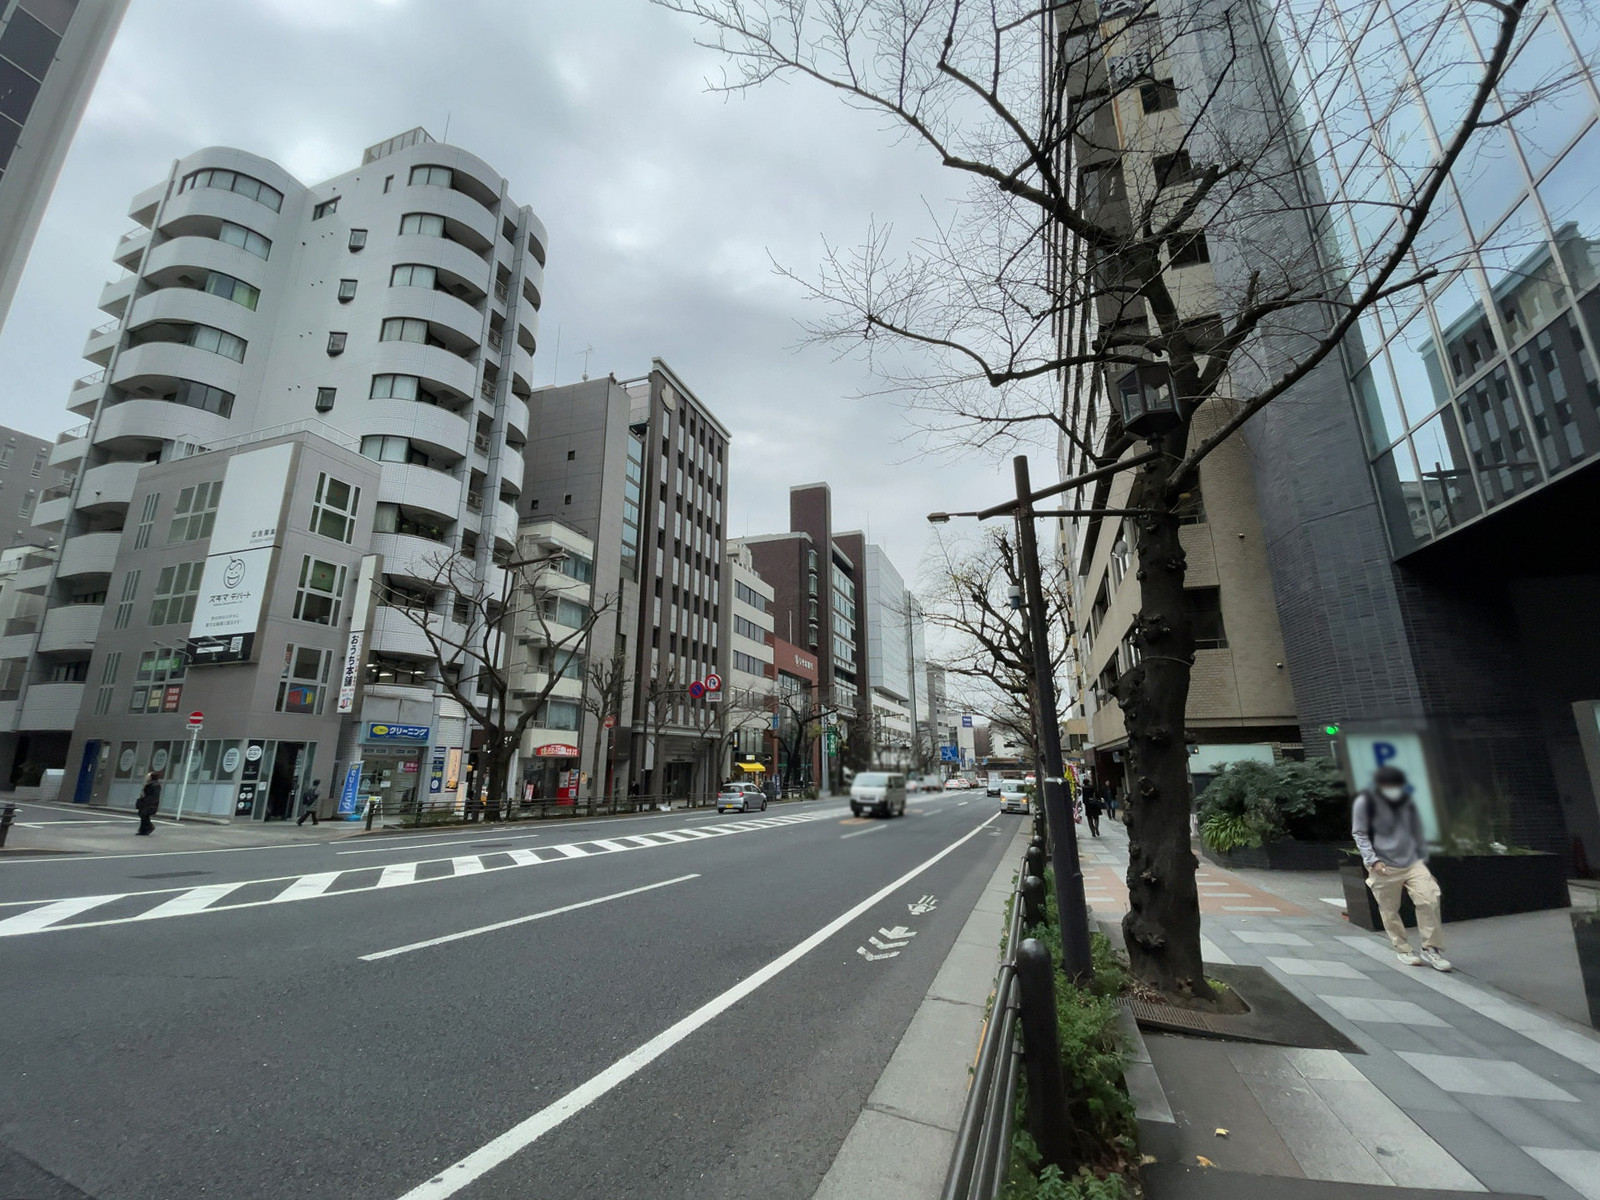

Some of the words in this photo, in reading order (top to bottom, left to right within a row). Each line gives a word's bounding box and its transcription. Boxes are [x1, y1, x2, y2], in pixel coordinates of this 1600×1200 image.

[389, 726, 428, 736] クリーニング
[1372, 742, 1397, 768] P
[341, 770, 356, 810] クリーニング
